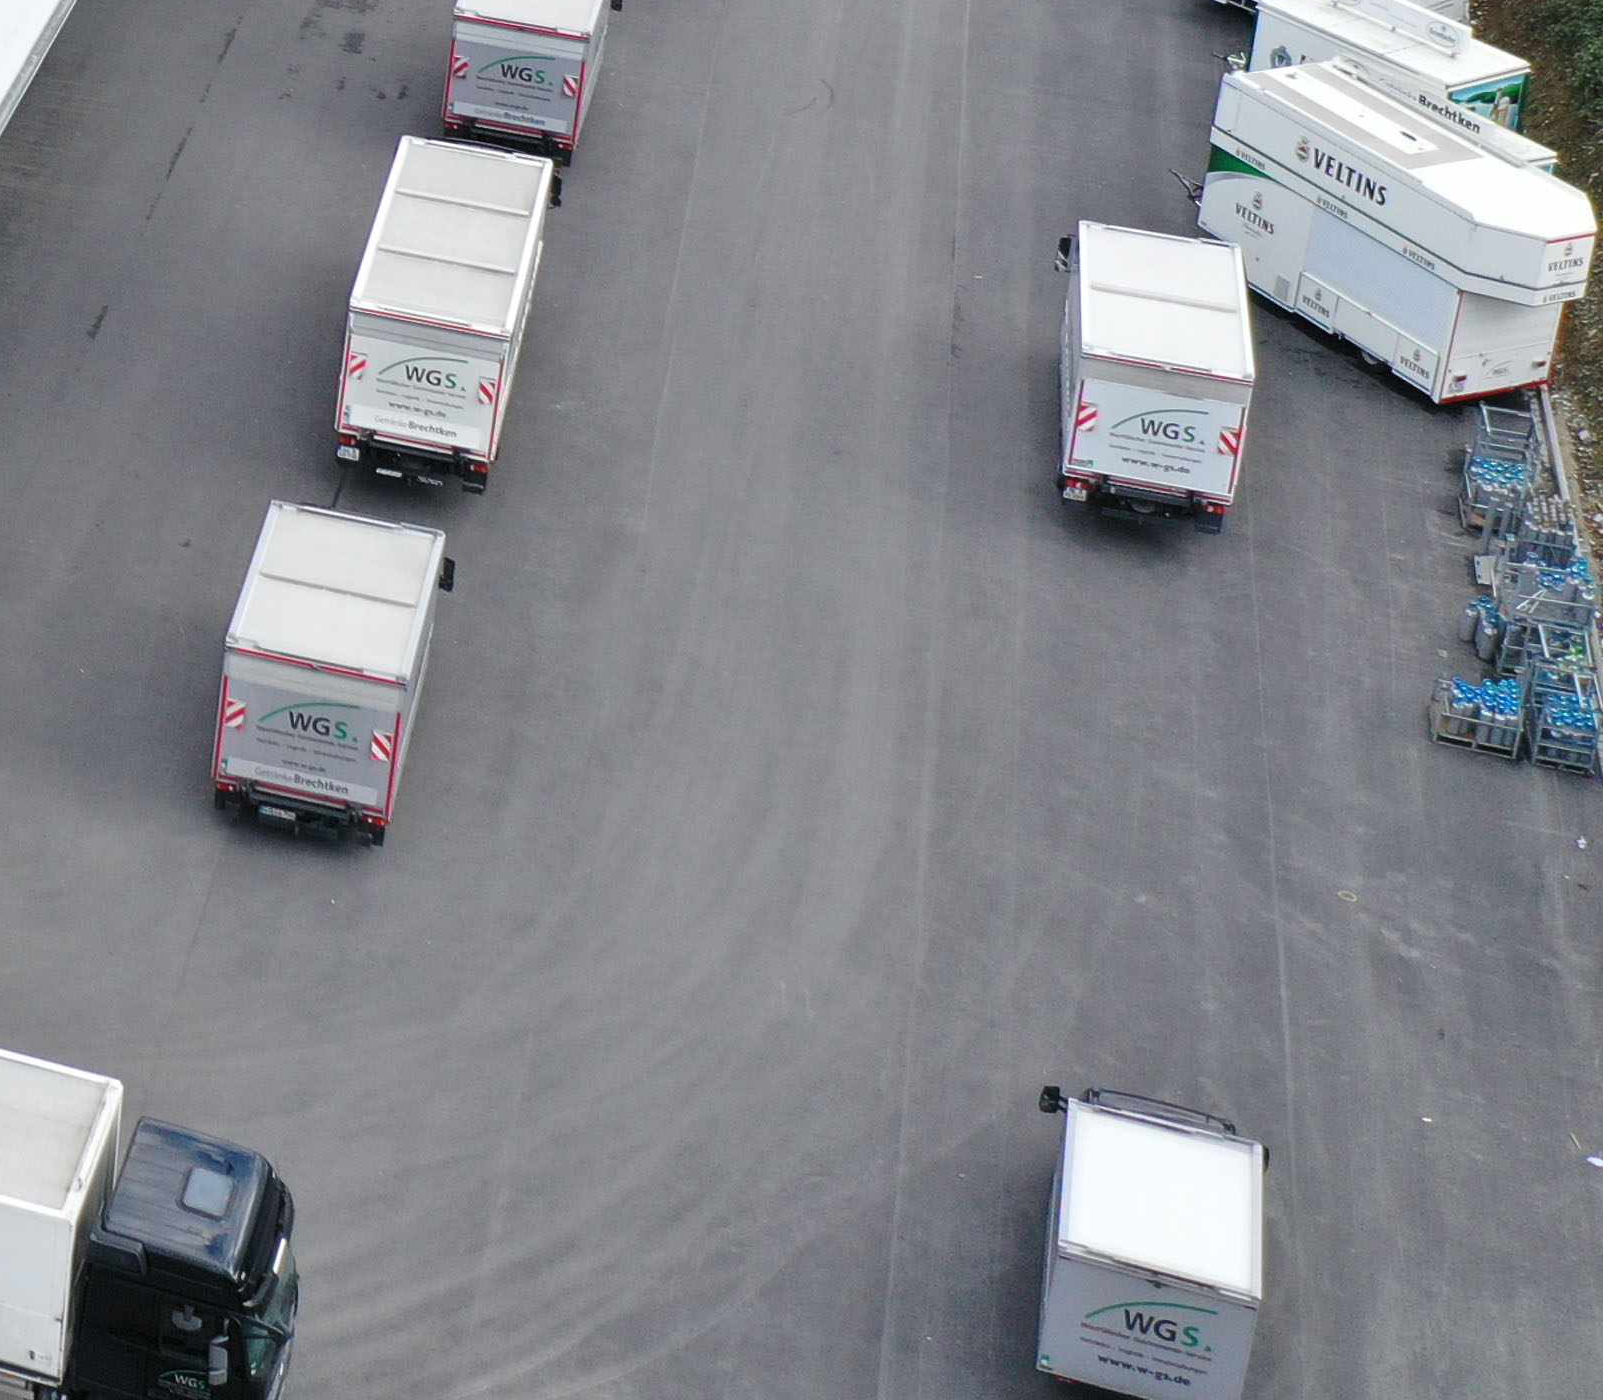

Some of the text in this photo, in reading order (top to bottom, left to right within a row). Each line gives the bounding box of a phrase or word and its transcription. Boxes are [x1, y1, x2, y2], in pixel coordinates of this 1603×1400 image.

[1419, 94, 1481, 134] Brechtken
[1313, 148, 1388, 206] VELTINS
[1235, 202, 1275, 236] VELTINS
[1548, 256, 1584, 273] VELTINS
[293, 773, 349, 795] Brechtken
